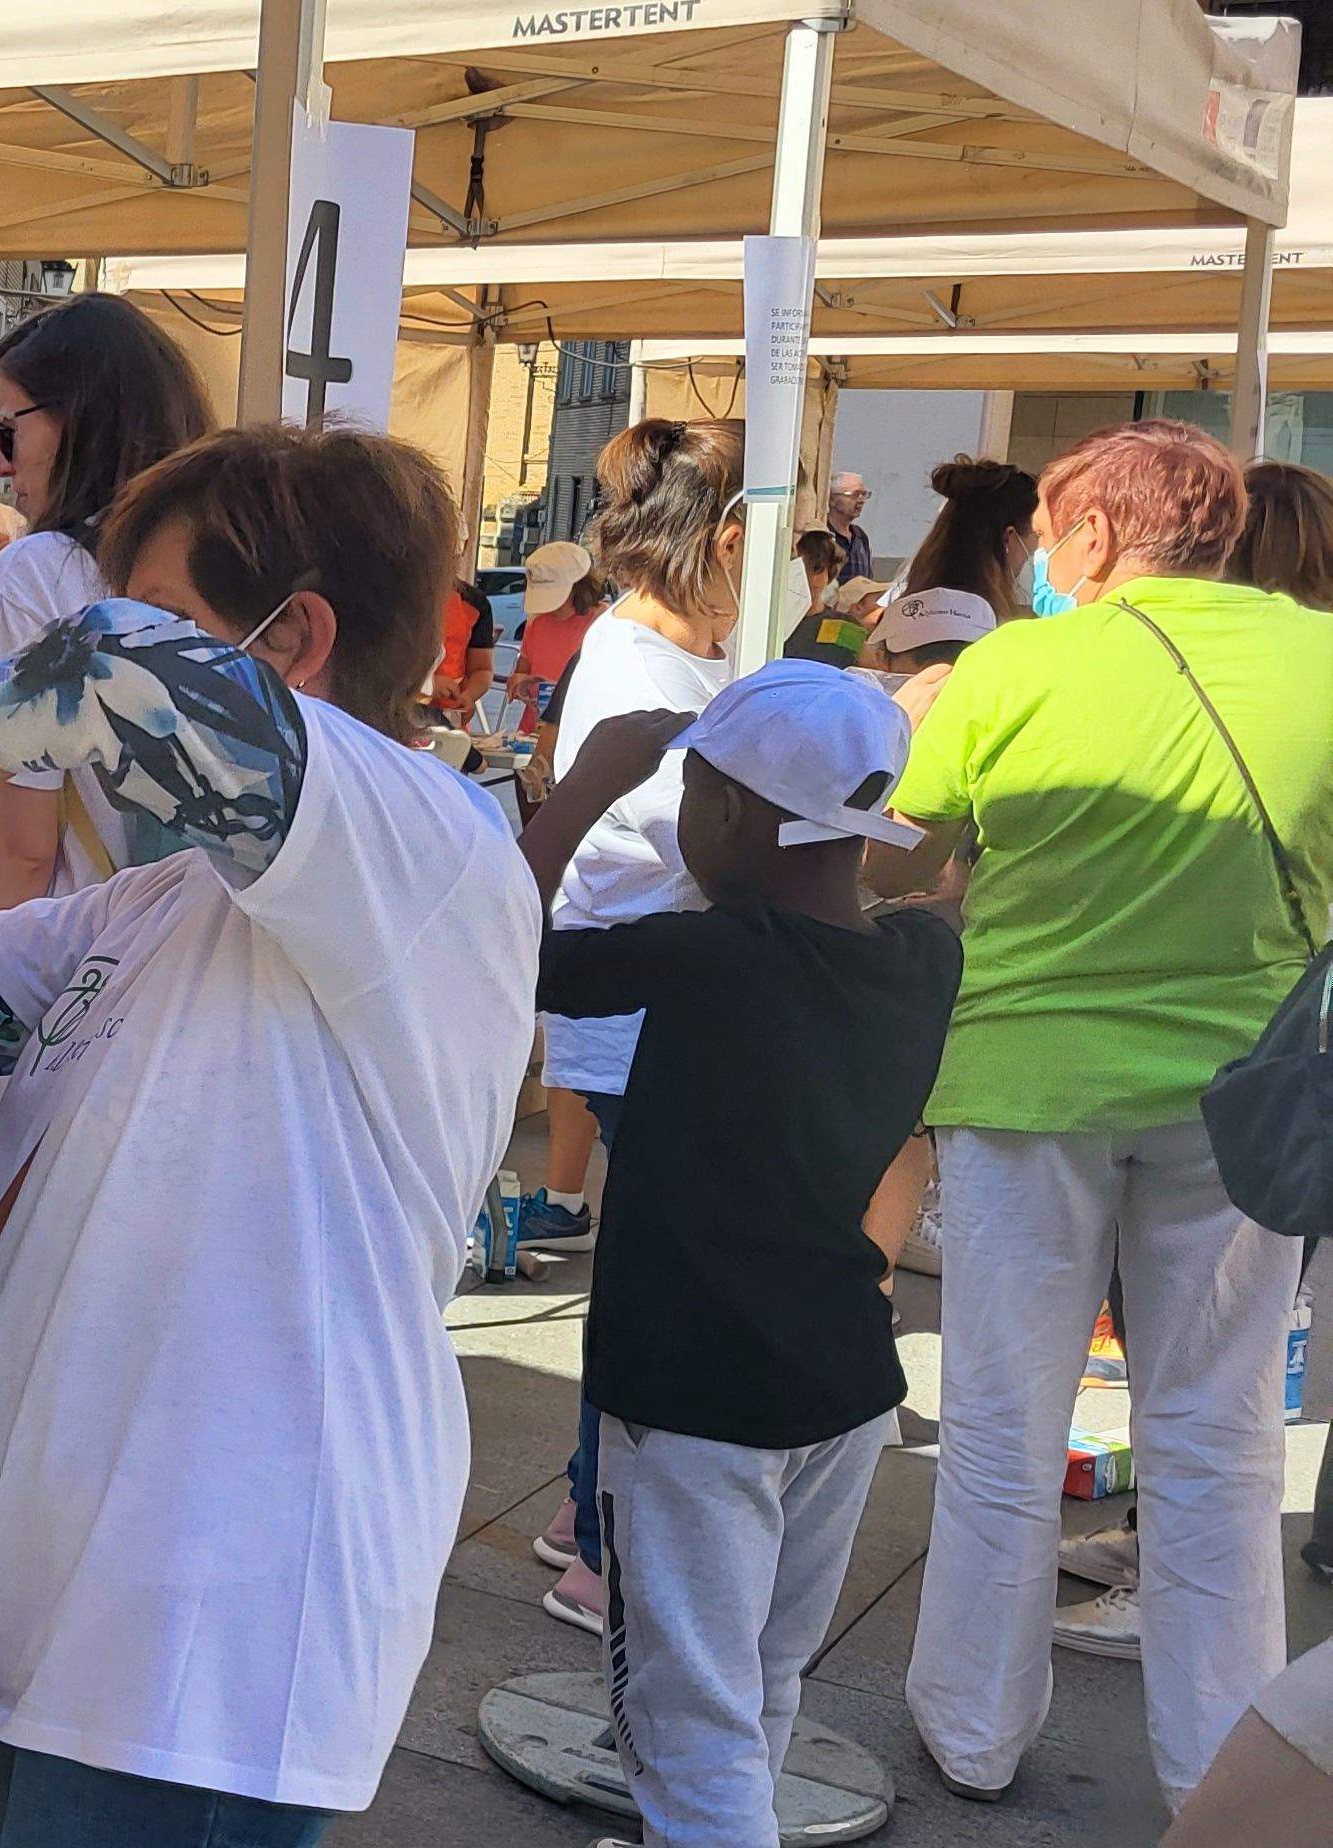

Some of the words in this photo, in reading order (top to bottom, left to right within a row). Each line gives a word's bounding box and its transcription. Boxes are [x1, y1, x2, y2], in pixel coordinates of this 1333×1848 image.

[513, 0, 701, 38] MASTERTENT
[1191, 252, 1304, 266] MASTEENT
[285, 200, 352, 434] 4
